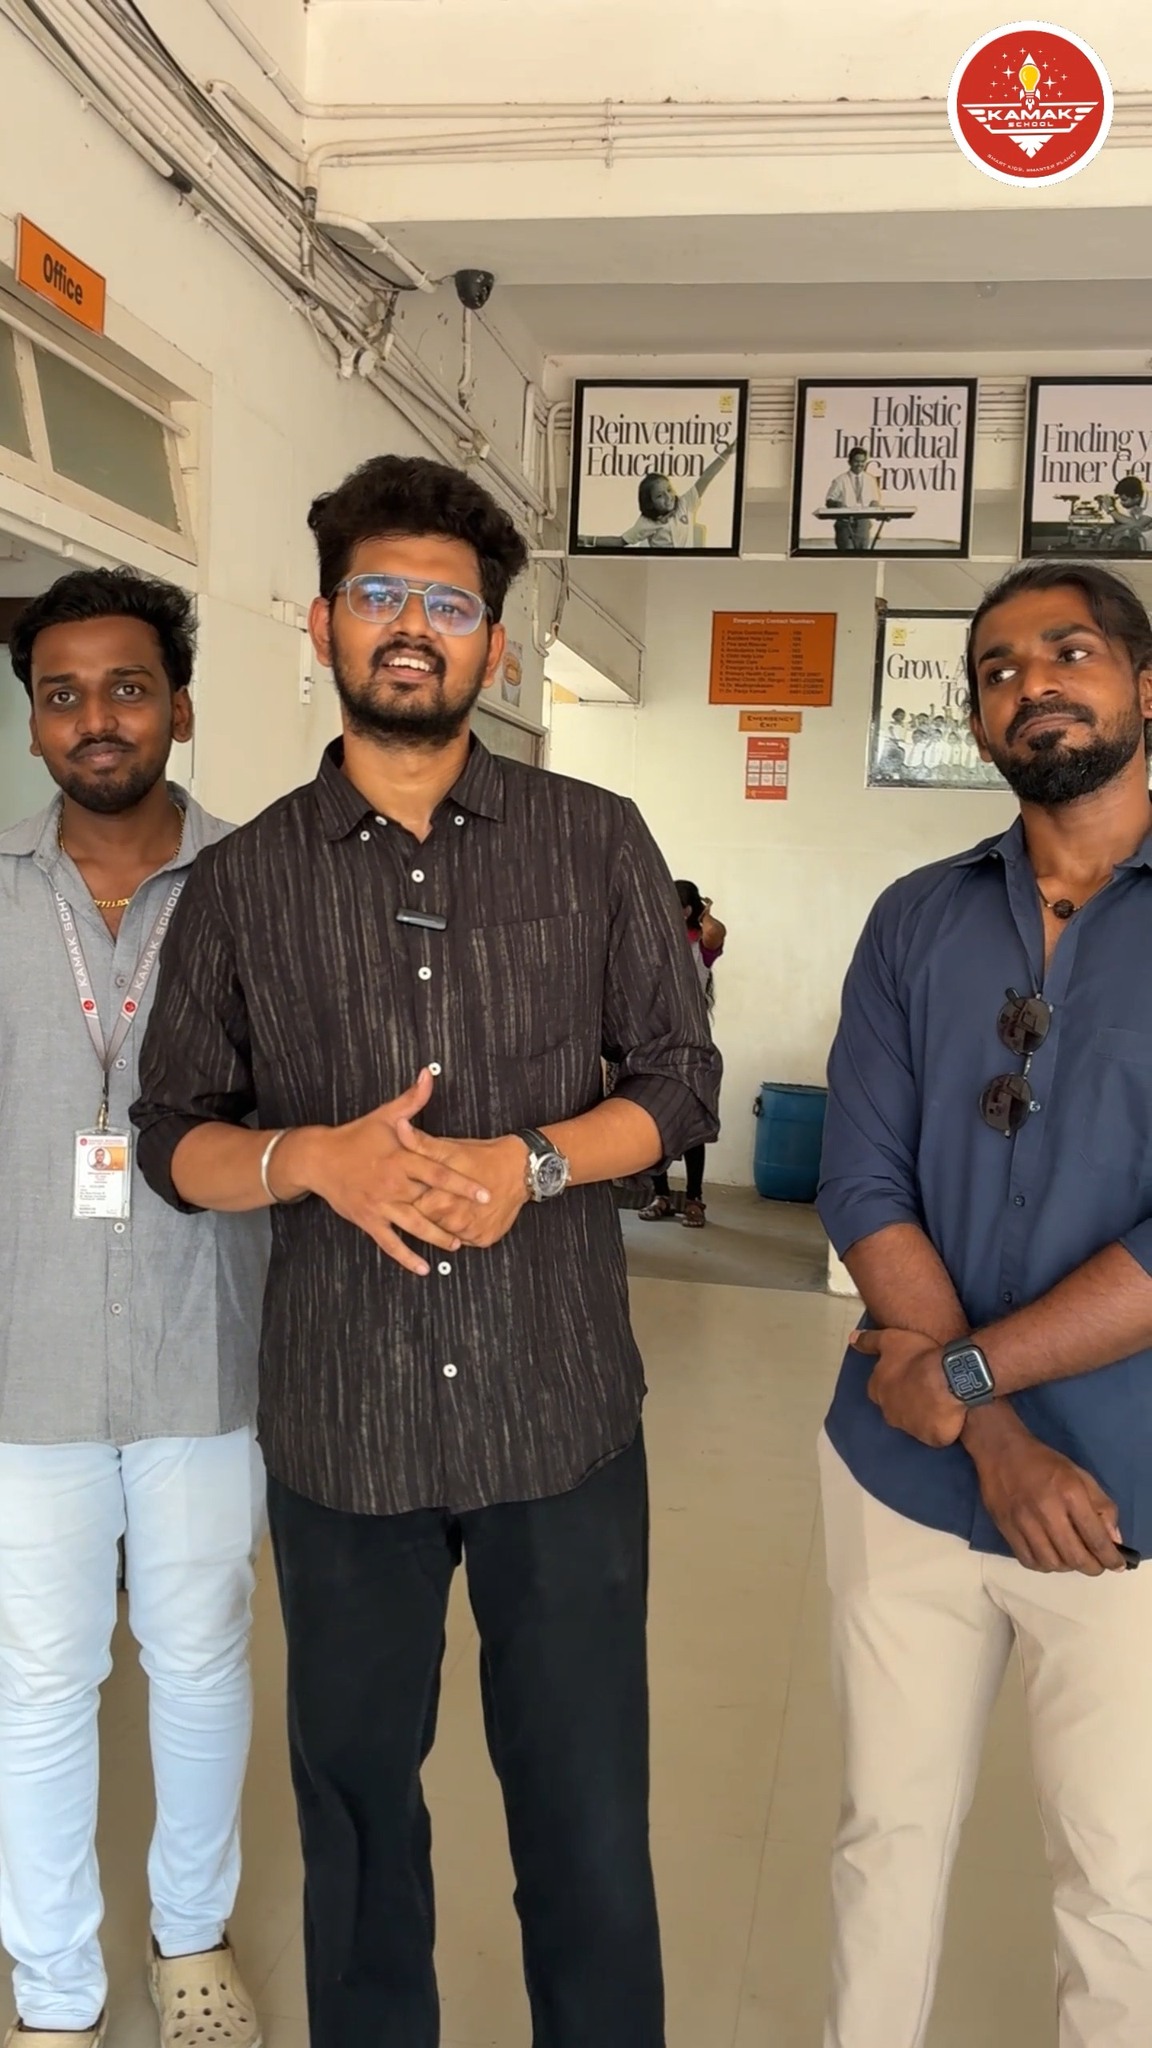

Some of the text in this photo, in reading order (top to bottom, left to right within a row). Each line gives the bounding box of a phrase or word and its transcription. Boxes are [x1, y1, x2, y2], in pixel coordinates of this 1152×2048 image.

[43, 253, 83, 306] Office
[872, 394, 962, 427] Holistic
[587, 413, 733, 457] Reinventing
[834, 427, 959, 459] Individual
[1041, 422, 1152, 461] Finding y
[586, 445, 705, 477] Education
[1038, 454, 1108, 483] Inner
[887, 653, 968, 680] Grow. A
[941, 681, 970, 708] To
[55, 891, 88, 987] KAMAK SCHO
[134, 880, 185, 990] KAMAK SCHOOL
